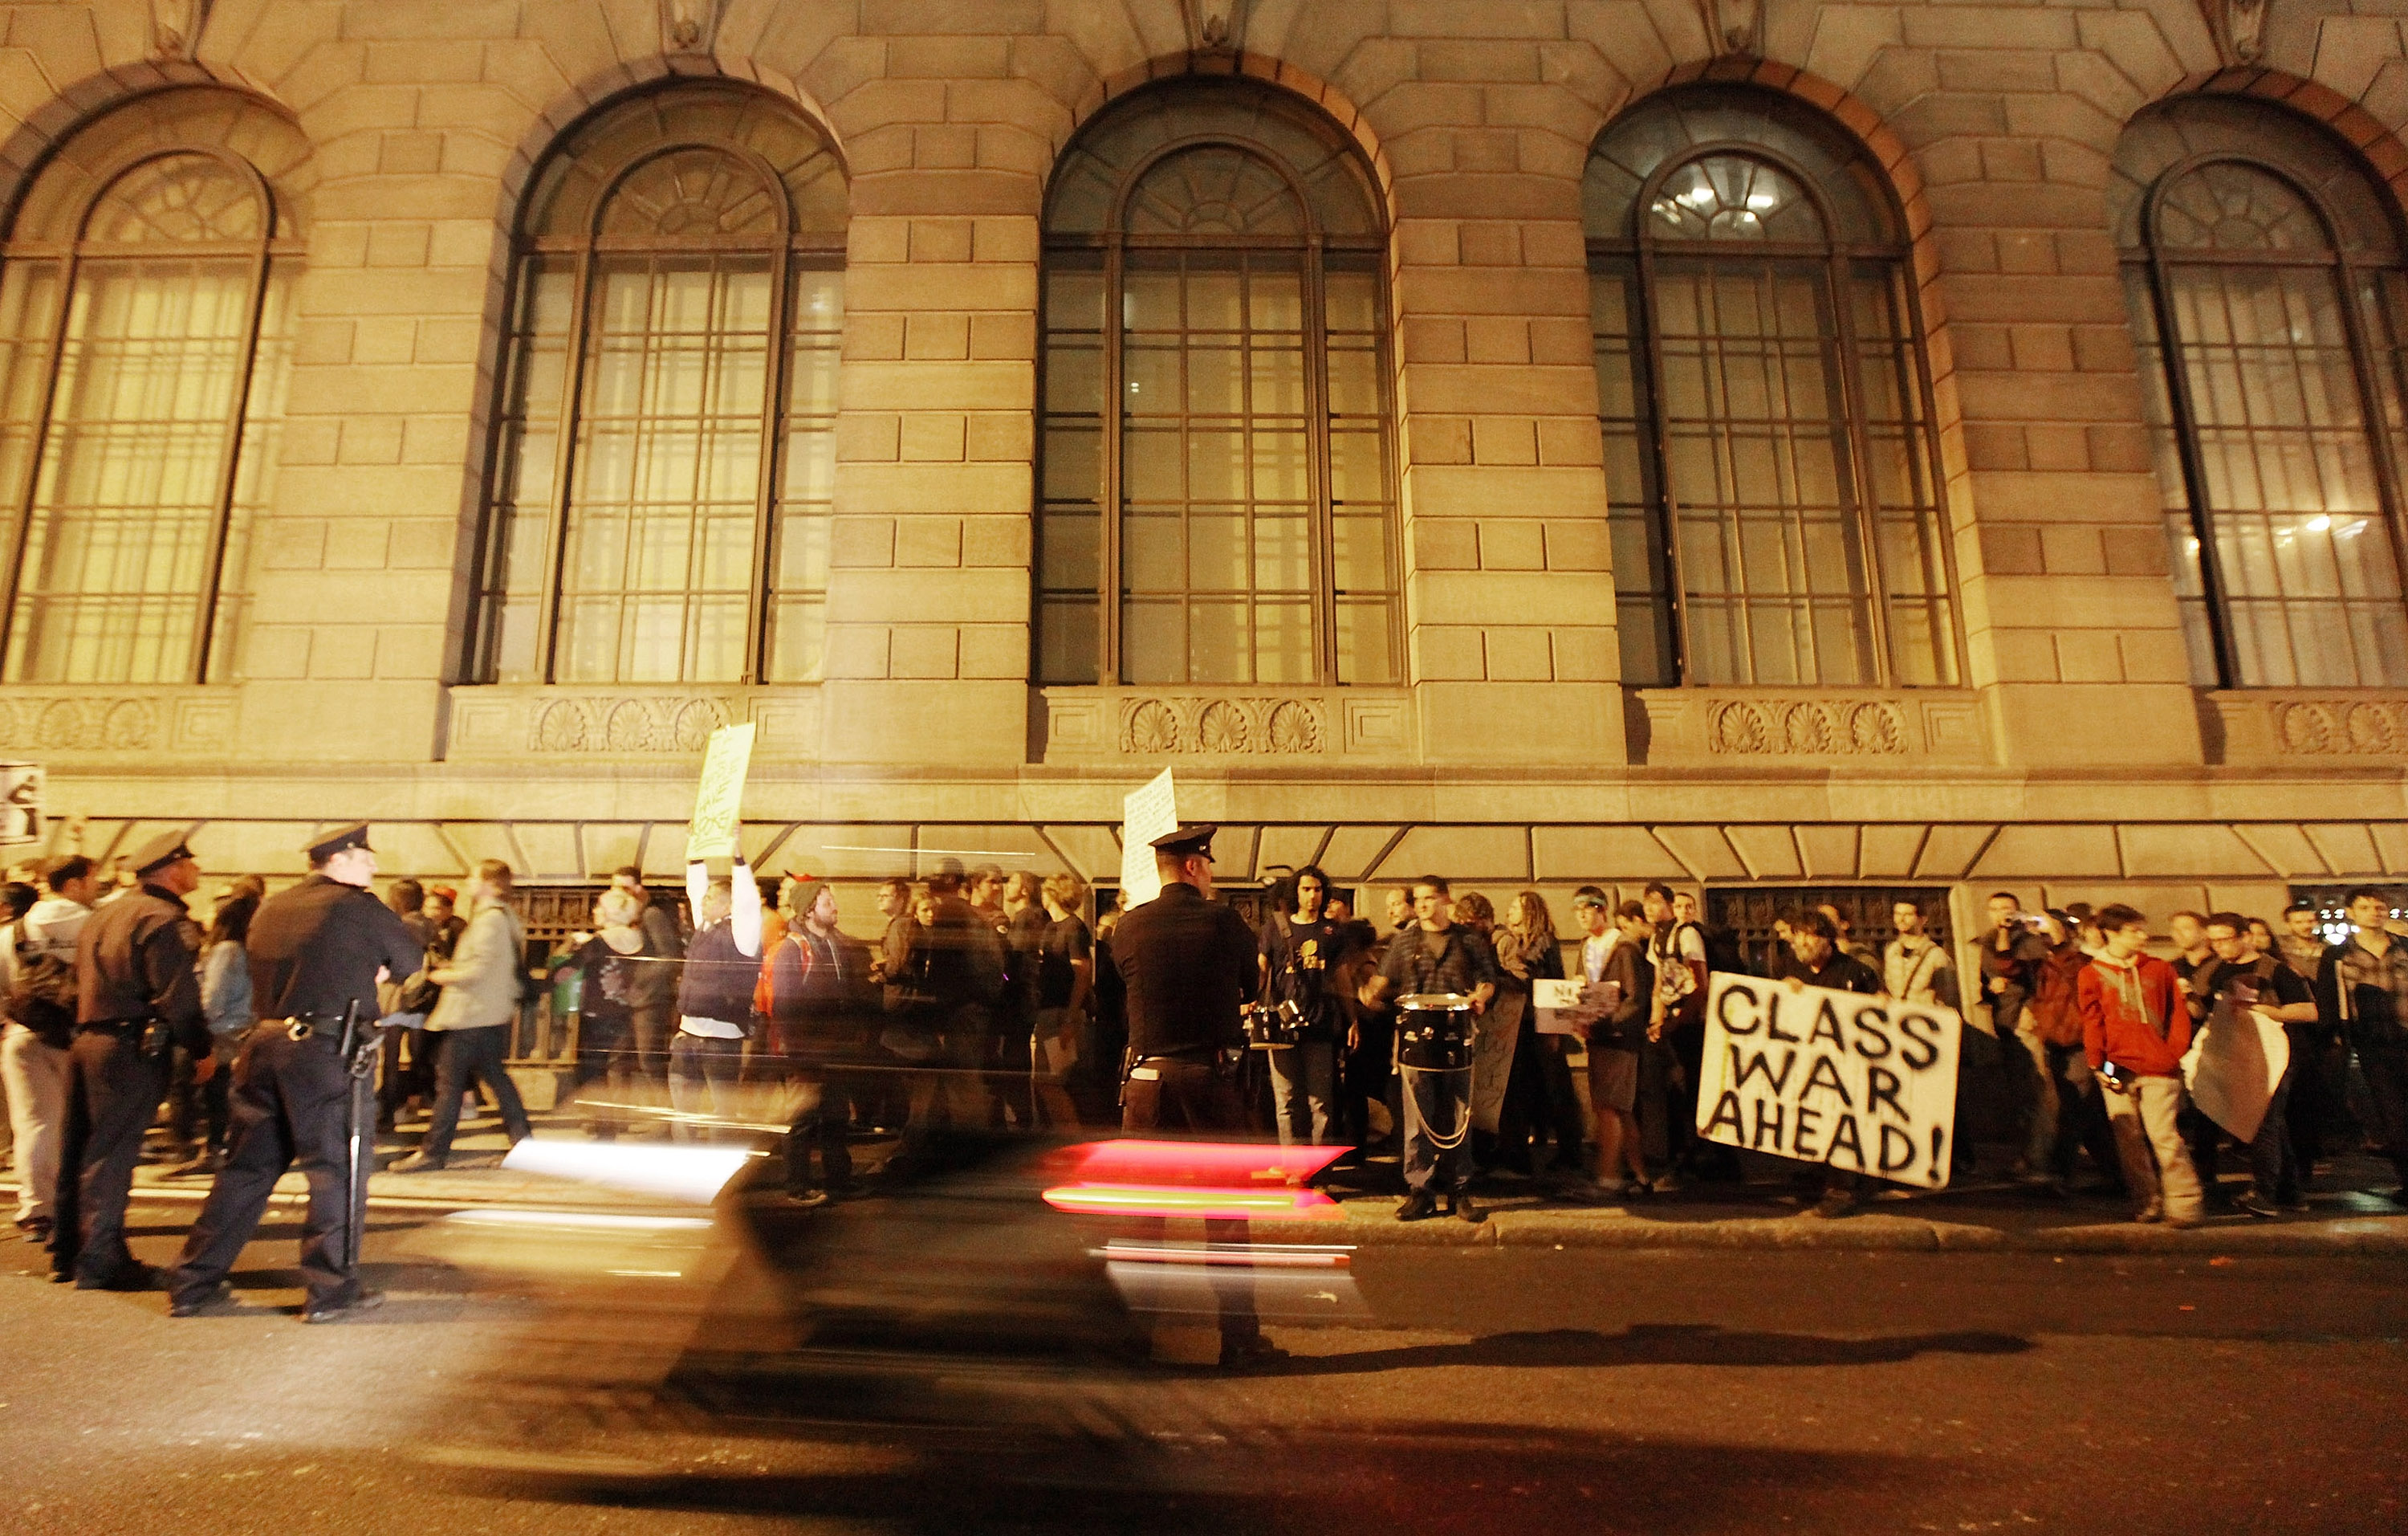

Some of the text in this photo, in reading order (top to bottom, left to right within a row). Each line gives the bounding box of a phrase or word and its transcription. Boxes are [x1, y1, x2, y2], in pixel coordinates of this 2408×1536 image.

[1718, 984, 1940, 1070] CLASS
[1729, 1044, 1910, 1123] WAR
[1702, 1090, 1943, 1181] AHEAD!
